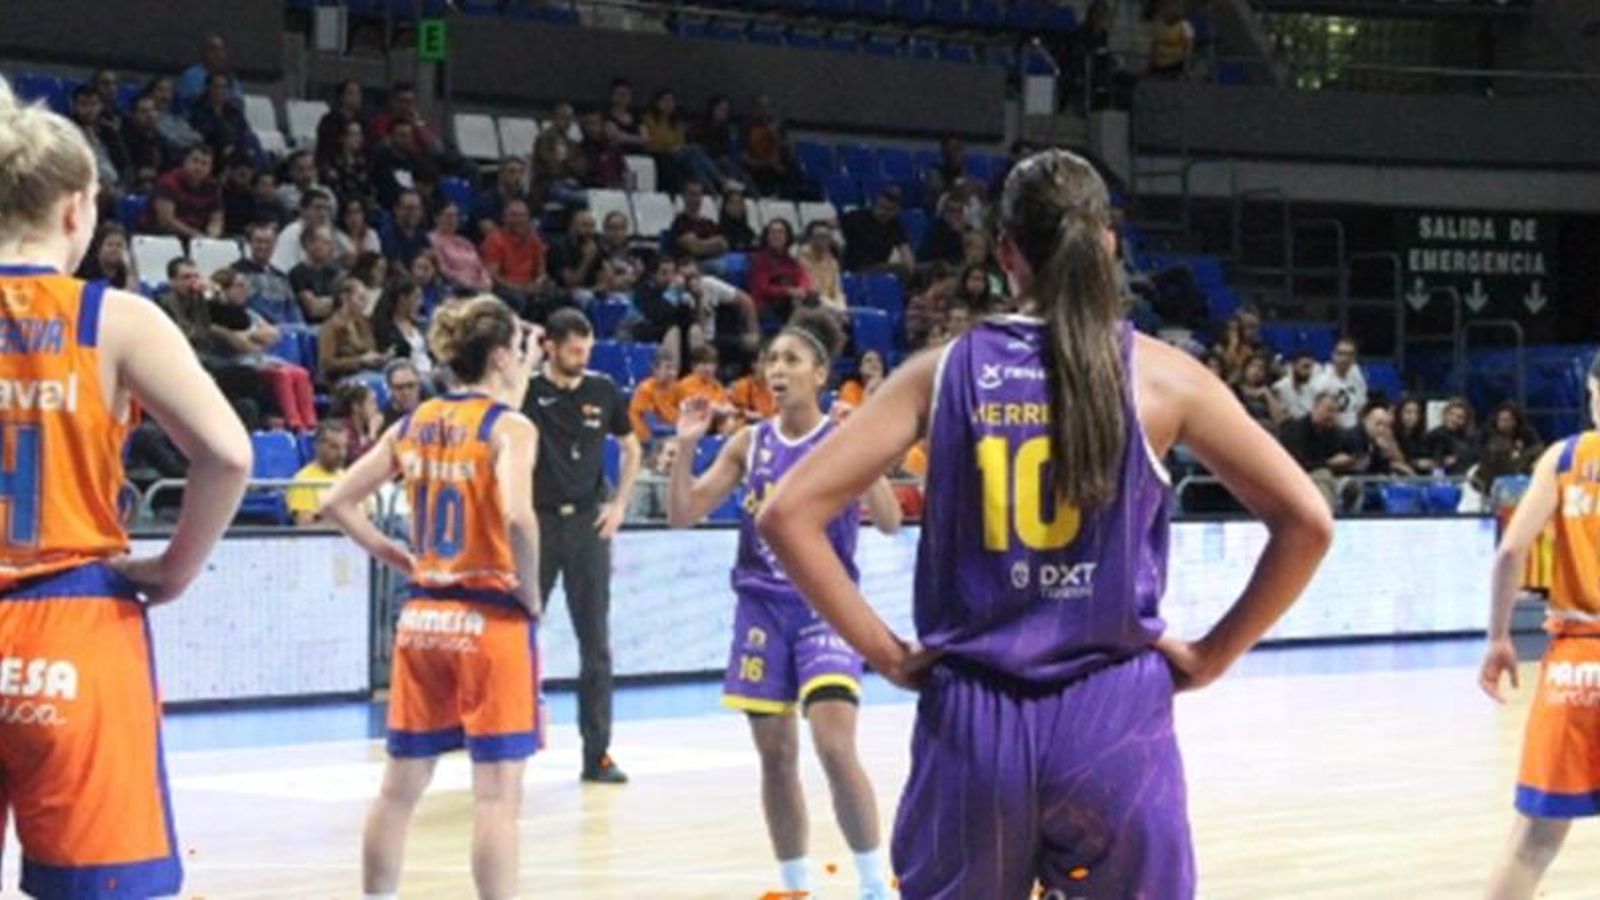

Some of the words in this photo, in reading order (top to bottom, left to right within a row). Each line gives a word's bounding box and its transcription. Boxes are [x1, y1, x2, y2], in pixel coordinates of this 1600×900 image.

[425, 25, 440, 51] E
[1418, 215, 1495, 240] SALIDA
[1509, 218, 1537, 242] DE
[1408, 249, 1546, 274] EMERGENCIA
[977, 434, 1081, 552] 10
[1040, 562, 1096, 586] DXT
[740, 655, 764, 682] 16
